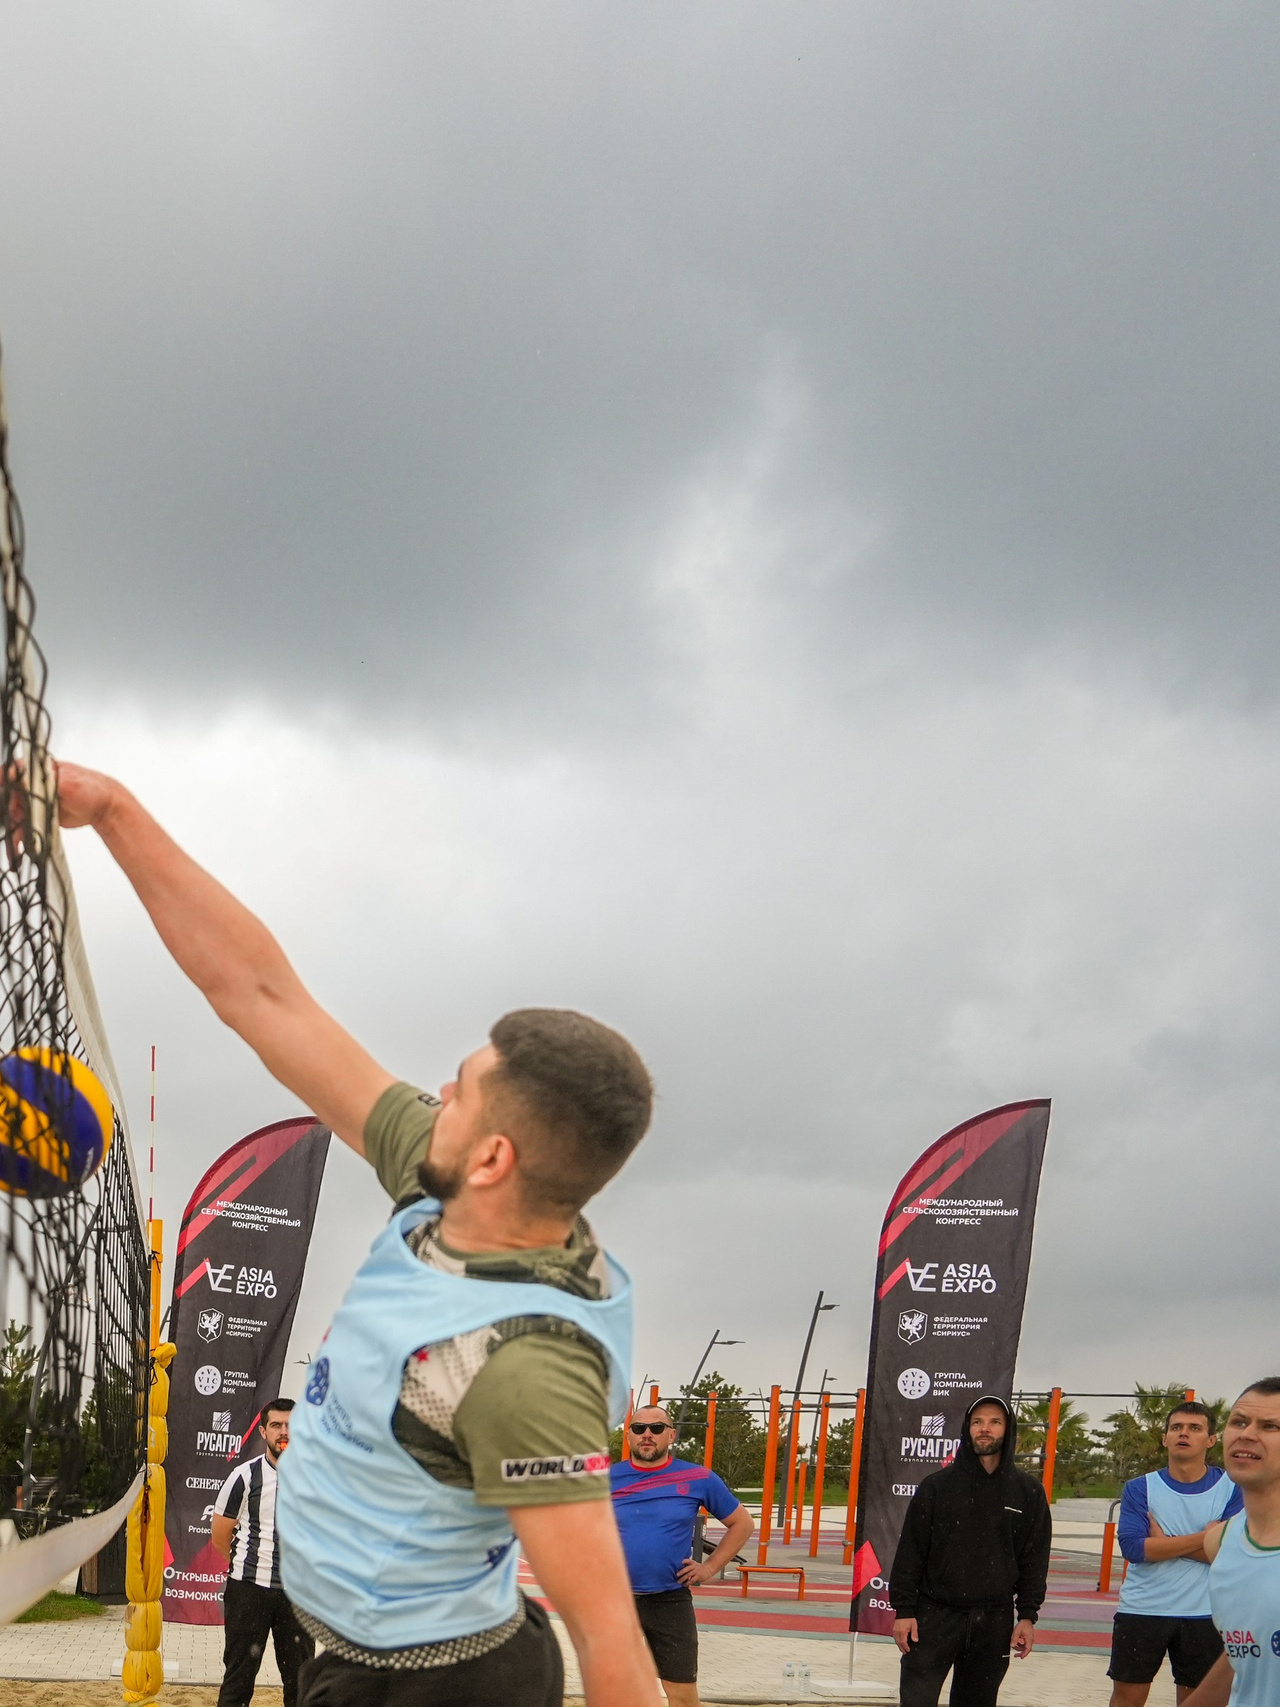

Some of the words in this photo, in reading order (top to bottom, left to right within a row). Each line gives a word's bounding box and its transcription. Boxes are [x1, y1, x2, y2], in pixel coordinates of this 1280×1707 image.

[216, 1200, 288, 1217] МЕЖДУНАРОДНЫЙ
[919, 1198, 1003, 1207] МЕЖДУНАРОДНЫЙ
[201, 1207, 301, 1228] СЕЛЬСКОХОЗЯЙСТВЕННЫЙ
[902, 1206, 1019, 1217] СЕЛЬСКОХОЗЯЙСТВЕННЫЙ
[231, 1220, 269, 1232] КОНГРЕСС
[935, 1217, 982, 1225] КОНГРЕСС
[237, 1266, 275, 1284] ASIA
[942, 1263, 992, 1278] ASIA
[236, 1281, 278, 1299] EXPO
[941, 1278, 997, 1293] EXPO
[224, 1370, 249, 1379] ГРУППА
[934, 1372, 967, 1380] ГРУППА
[223, 1379, 257, 1388] КОМПАНИЙ
[933, 1380, 983, 1388] КОМПАНИЙ
[222, 1386, 236, 1395] ВИК
[196, 1431, 242, 1453] РУСАГРО
[188, 1525, 212, 1534] Protec
[1226, 1630, 1255, 1644] ASIA
[1228, 1645, 1261, 1658] EXPO
